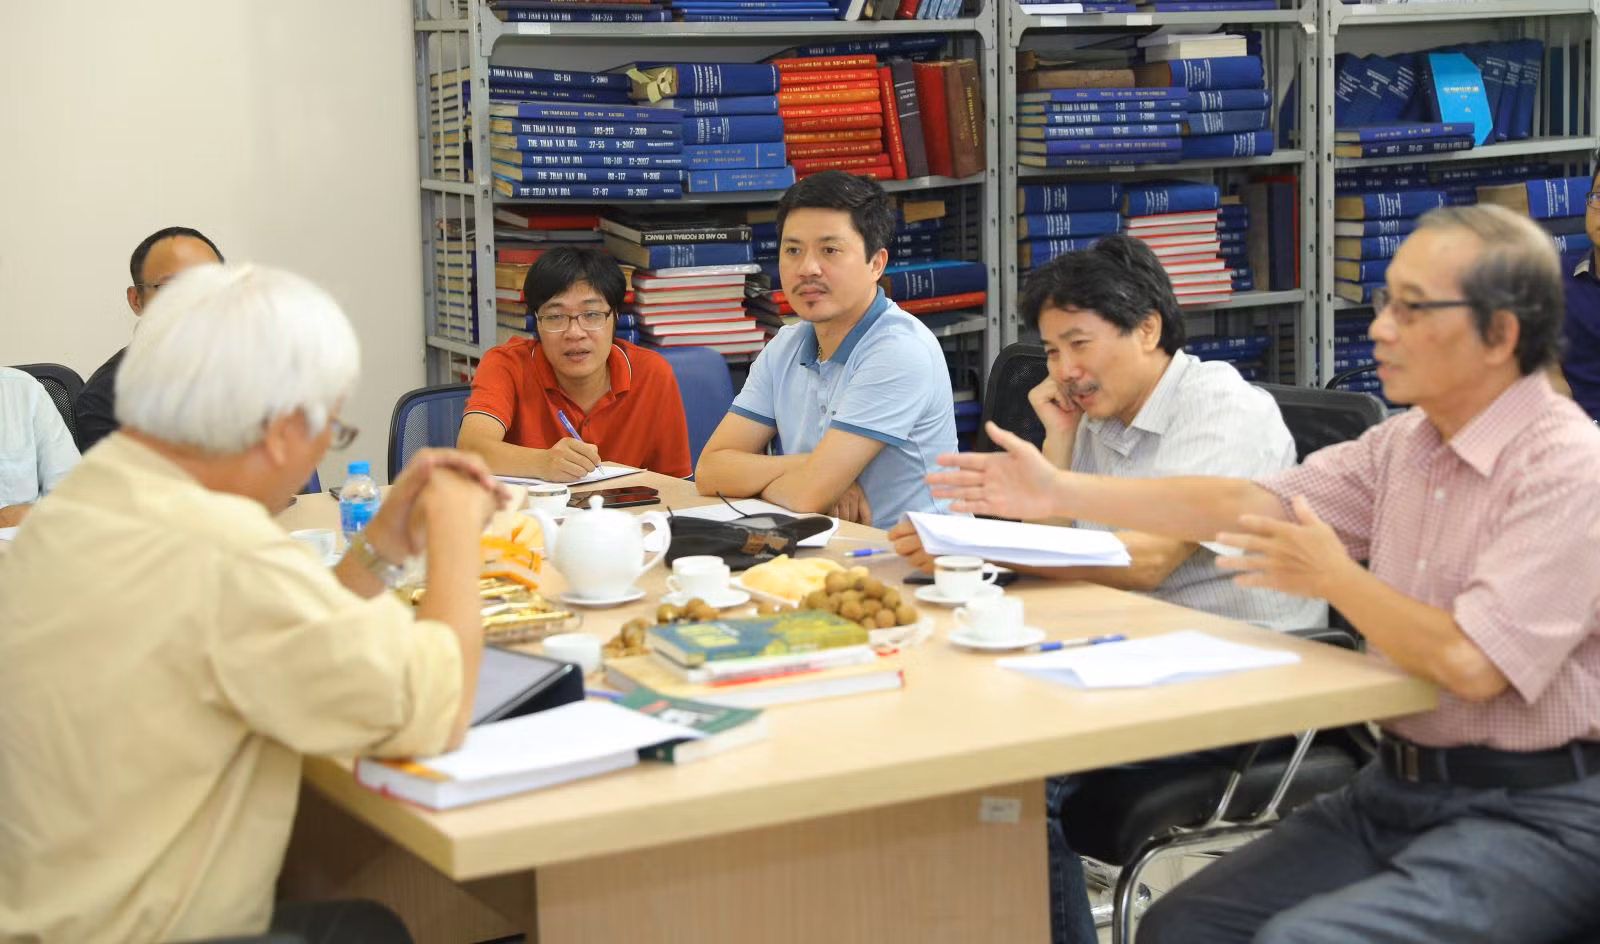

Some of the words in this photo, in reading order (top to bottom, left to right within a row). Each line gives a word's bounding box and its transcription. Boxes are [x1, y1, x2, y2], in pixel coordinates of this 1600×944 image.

[522, 124, 532, 133] THE
[533, 125, 546, 133] THAO
[528, 139, 538, 148] THE
[540, 139, 553, 148] THAO
[555, 139, 565, 148] VAN
[567, 139, 578, 148] HOA
[533, 155, 543, 164] THE
[545, 155, 558, 164] THAO
[560, 156, 571, 164] VAN
[572, 156, 583, 164] HOA
[537, 171, 547, 180] THE
[549, 171, 563, 180] THAO
[520, 187, 530, 196] THE
[547, 187, 558, 196] VAN
[560, 187, 571, 196] HOA
